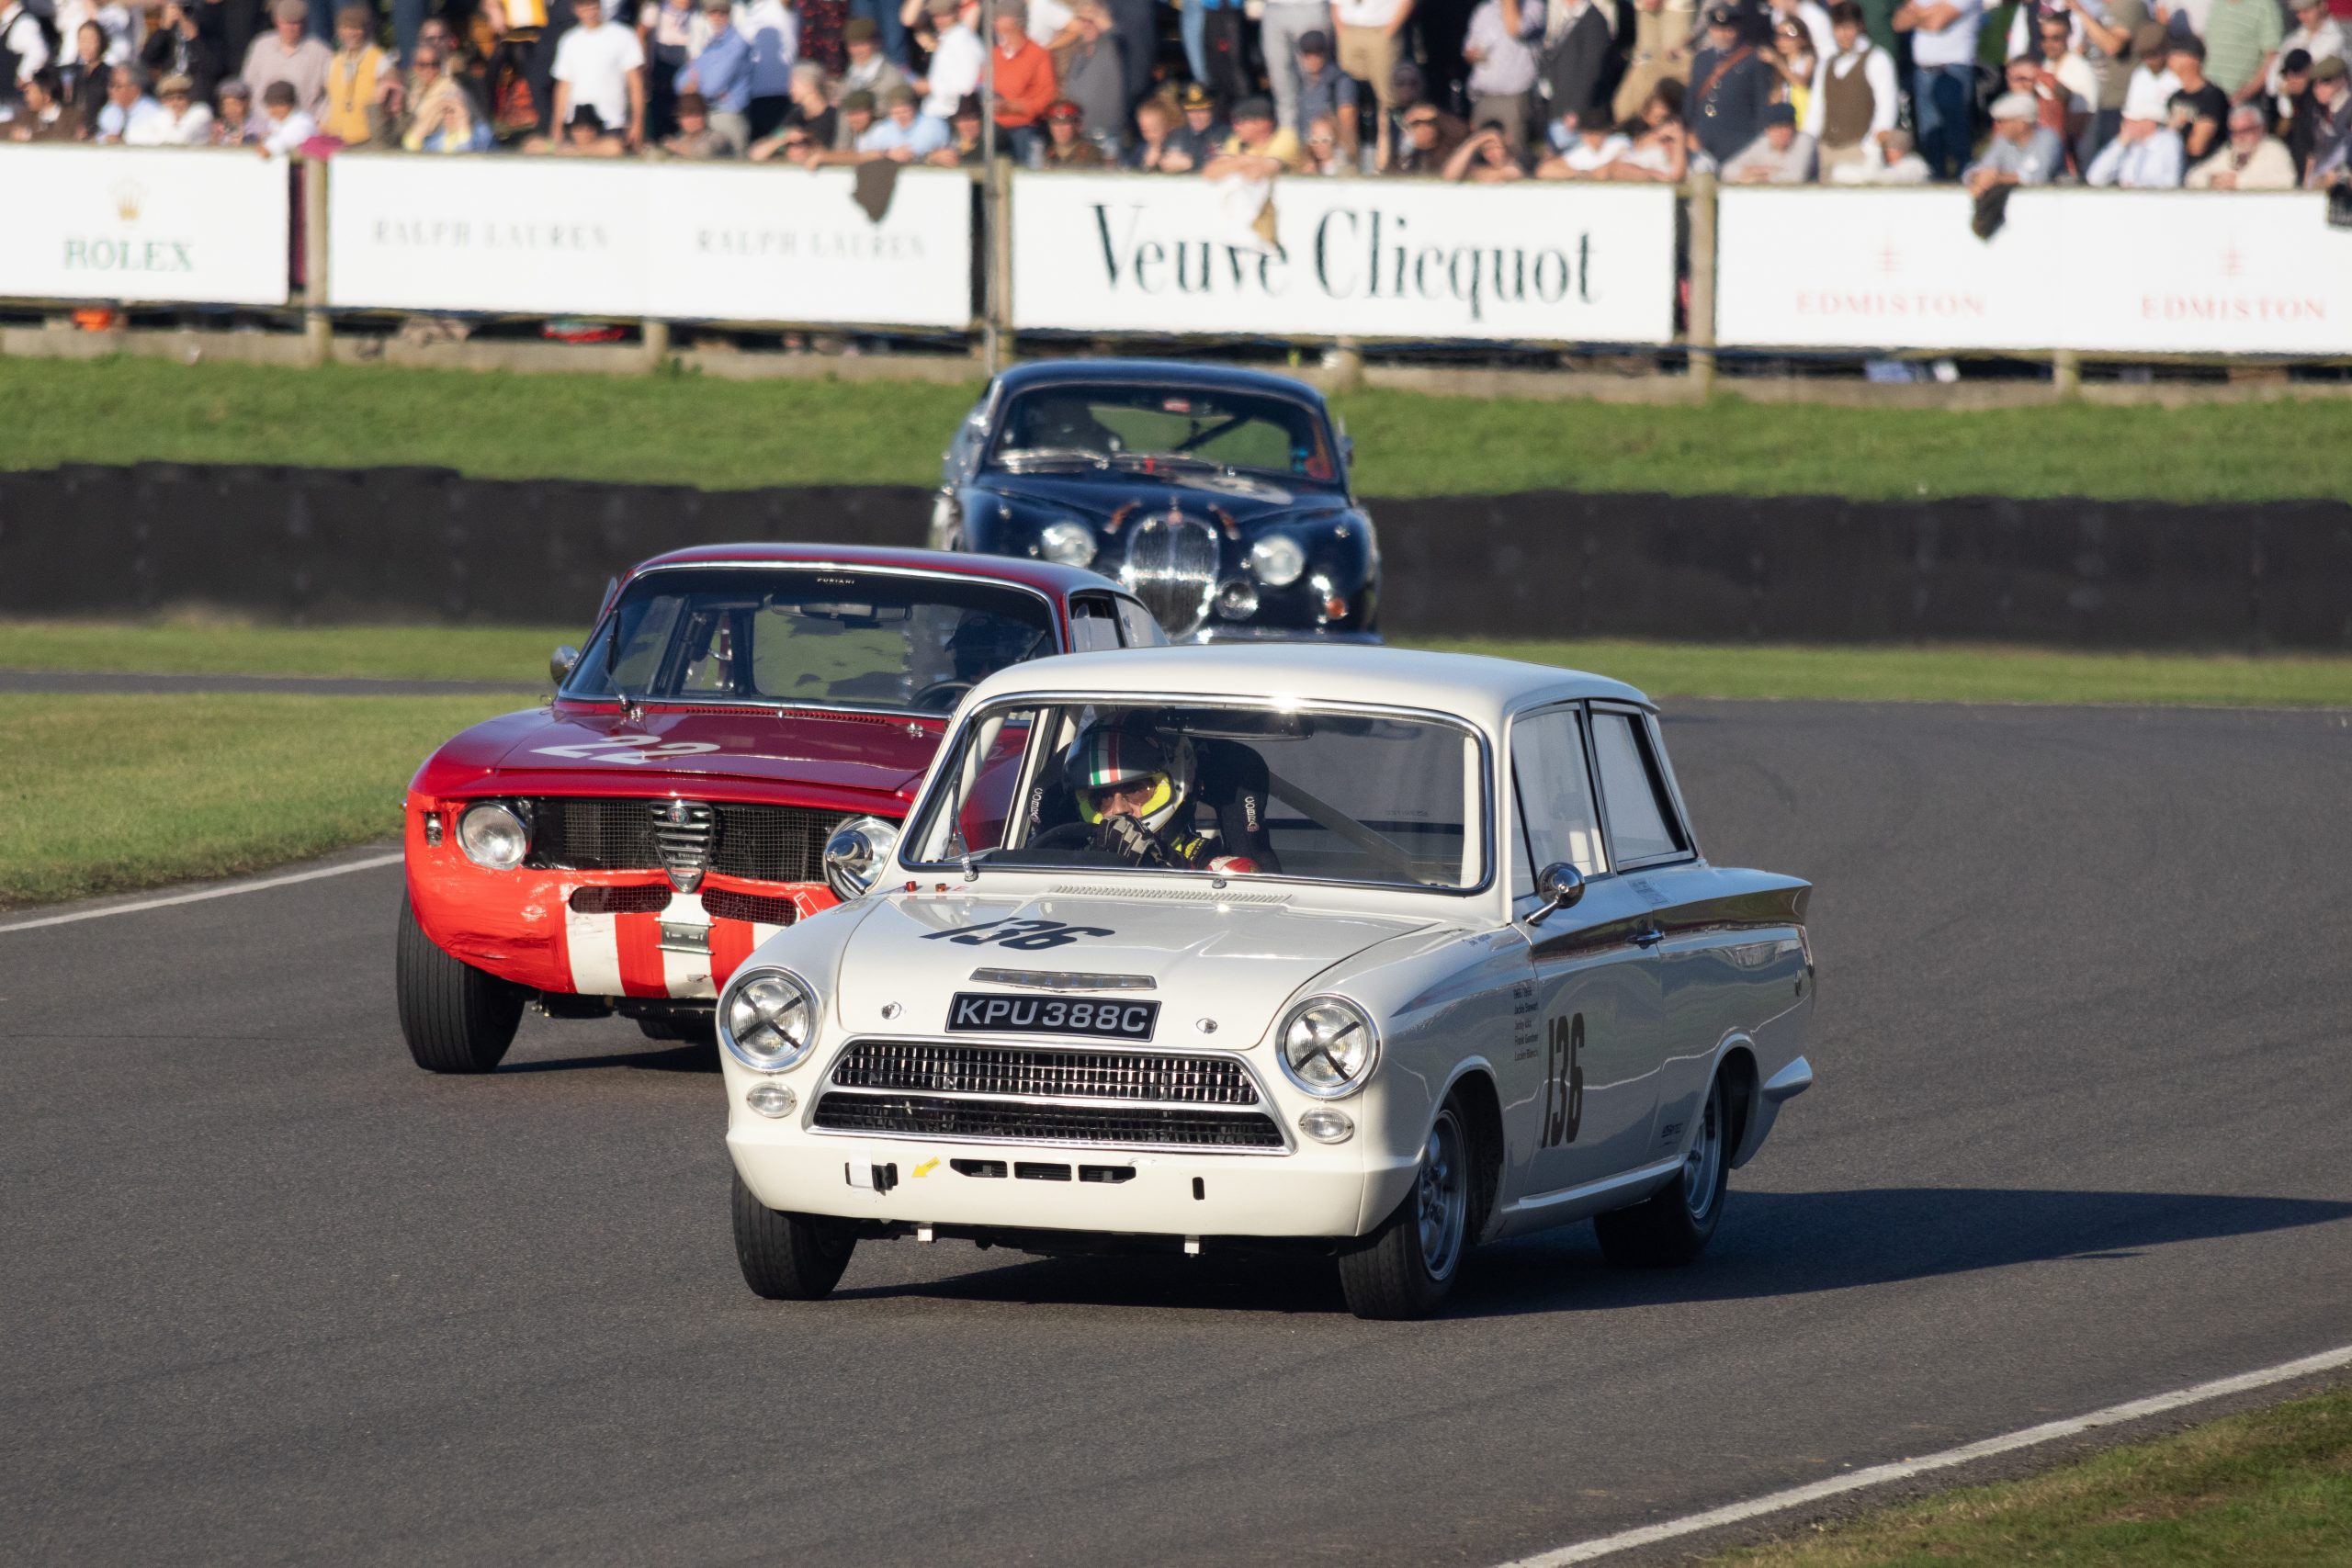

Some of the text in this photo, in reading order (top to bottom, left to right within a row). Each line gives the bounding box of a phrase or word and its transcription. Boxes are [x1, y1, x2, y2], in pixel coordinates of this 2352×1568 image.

[372, 219, 610, 250] RALPH LAUREN
[695, 229, 797, 257] RALPH
[63, 237, 194, 272] ROLEX
[1088, 202, 1602, 322] Veuve Clicquot
[1795, 292, 1985, 317] EDMISTON
[2140, 294, 2327, 321] EDMISTON
[918, 917, 1116, 951] 136
[1541, 1011, 1585, 1148] 136
